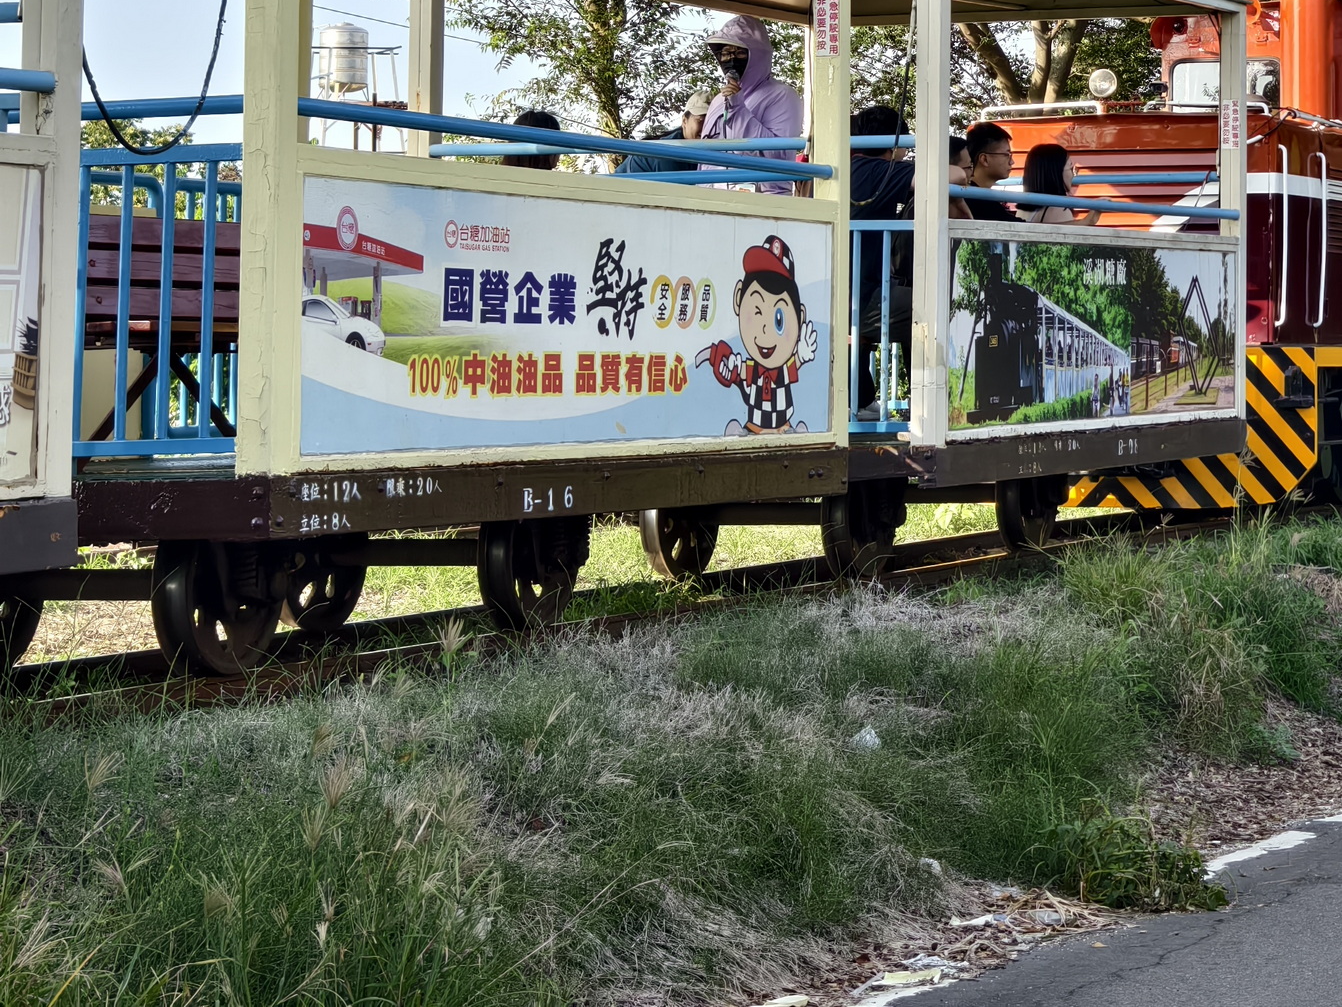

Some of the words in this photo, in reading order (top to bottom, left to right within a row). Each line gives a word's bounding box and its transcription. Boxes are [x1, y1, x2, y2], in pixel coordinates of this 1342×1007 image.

[459, 224, 511, 244] 台糖加油站
[459, 242, 481, 251] TAISUGAR
[481, 244, 491, 252] GAS
[492, 245, 510, 253] STATION
[443, 267, 577, 325] 國營企業
[657, 282, 670, 320] 安全
[678, 283, 691, 322] 服務
[699, 284, 711, 322] 品質
[407, 350, 564, 398] 100%中油油品
[574, 352, 690, 396] 品質有信心
